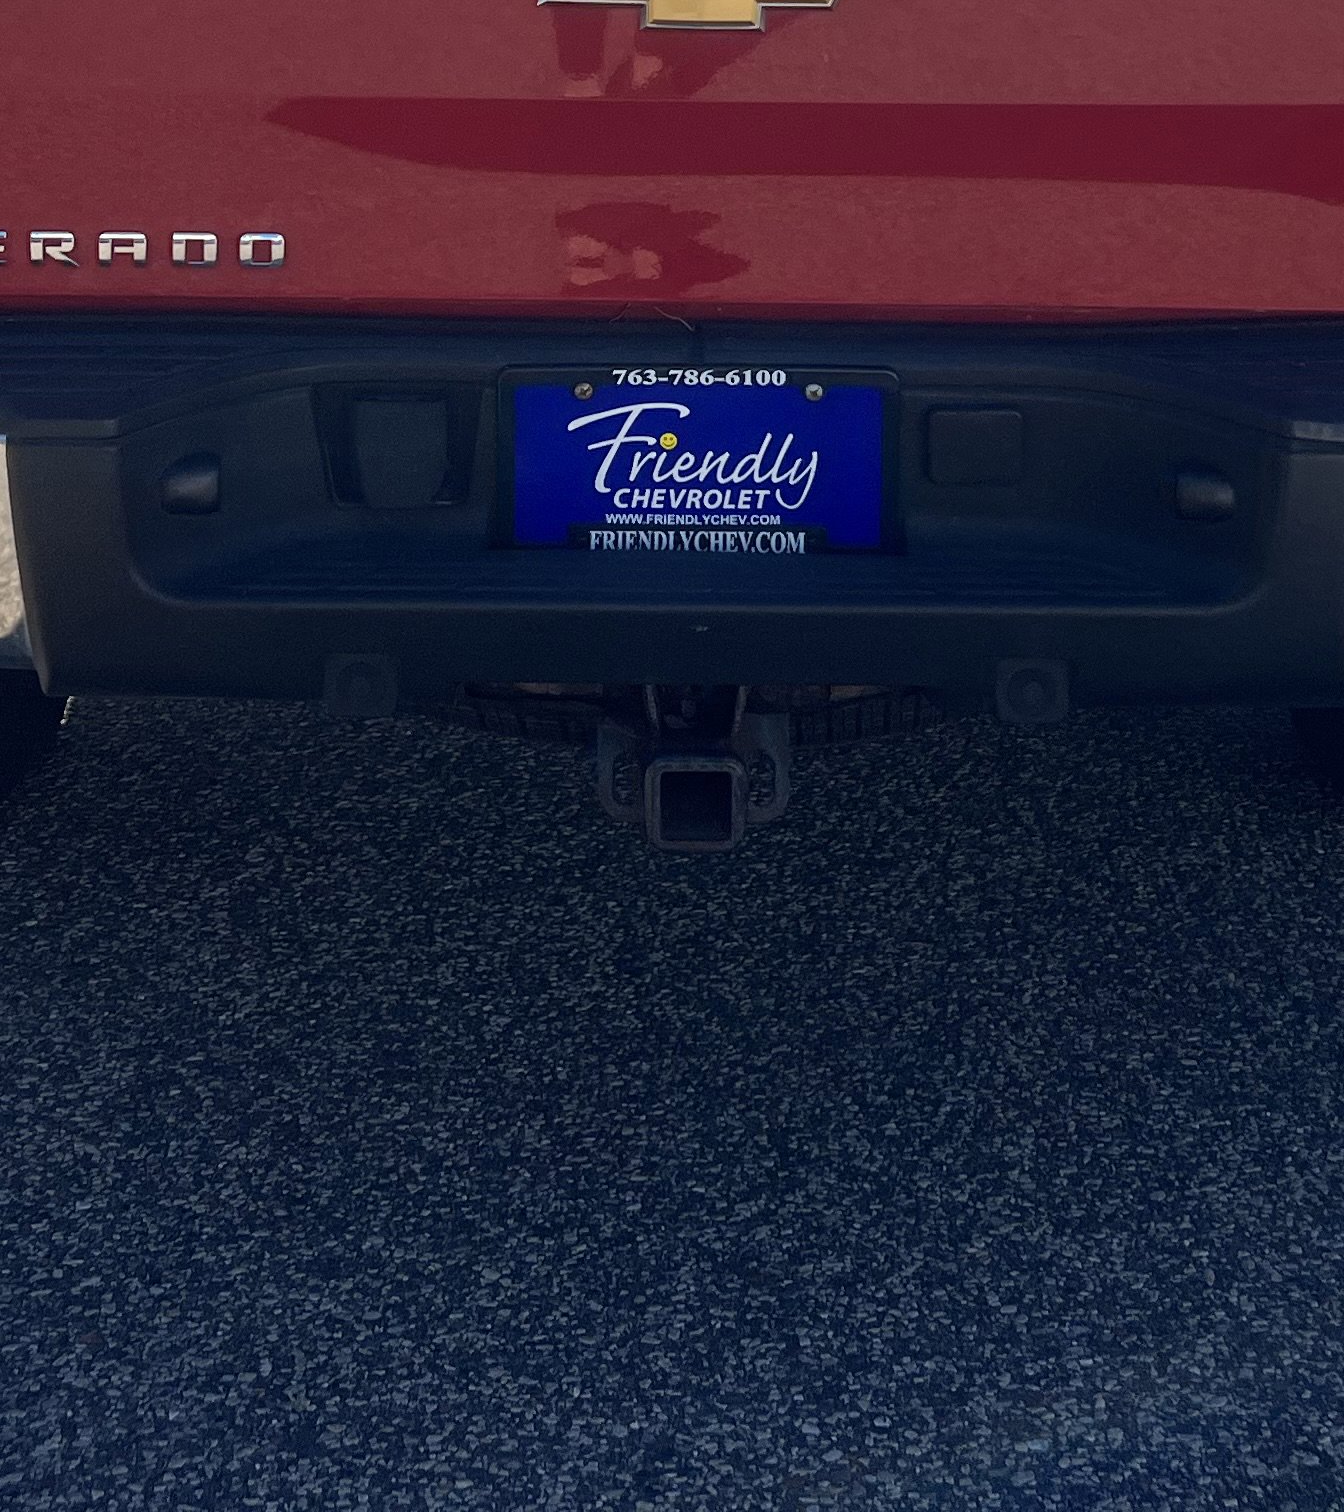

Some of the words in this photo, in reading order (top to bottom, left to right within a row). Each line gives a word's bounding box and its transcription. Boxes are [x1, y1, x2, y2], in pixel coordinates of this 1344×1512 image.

[612, 369, 787, 386] 763-786-6100
[567, 402, 819, 510] Friendly
[613, 488, 771, 510] CHEVROLET
[605, 513, 781, 525] WWW.FRIENDLYCHEV.COM
[589, 529, 806, 554] FRIENDLYCHEV.COM
